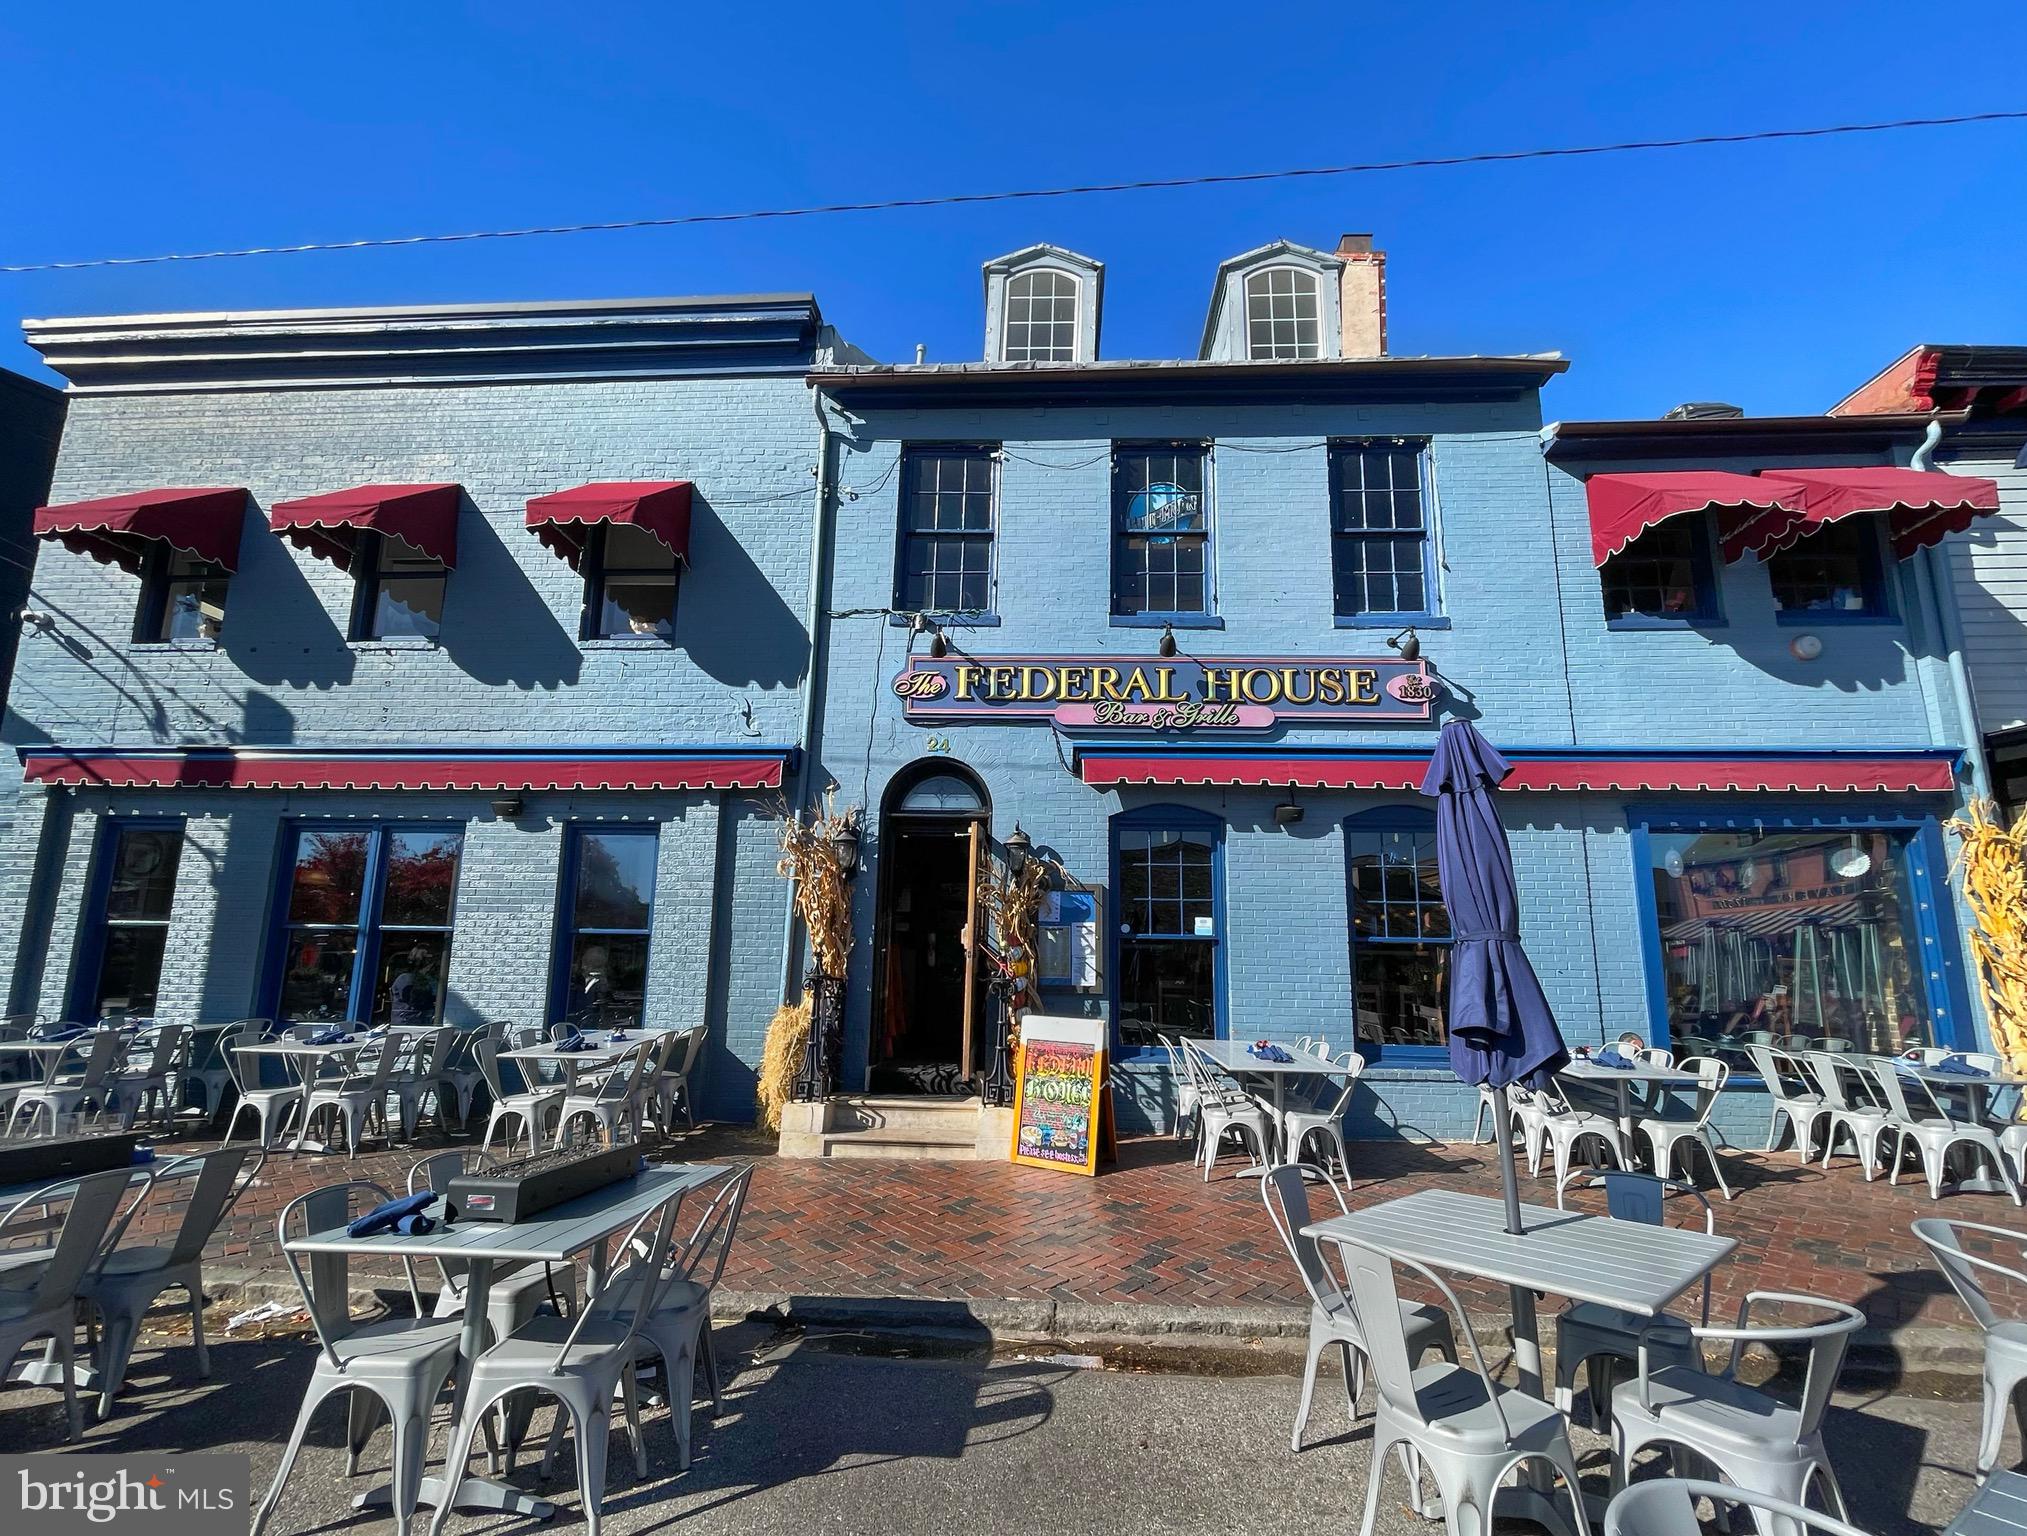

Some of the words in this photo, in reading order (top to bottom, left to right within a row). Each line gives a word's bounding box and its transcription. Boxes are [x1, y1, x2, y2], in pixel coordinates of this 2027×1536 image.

[893, 670, 944, 696] The
[954, 664, 1188, 702] FEDERAL
[1202, 667, 1380, 704] HOUSE
[1399, 685, 1433, 699] 1830
[1093, 700, 1149, 724] Bar
[1152, 706, 1171, 729] &
[1170, 700, 1240, 728] Grille
[927, 735, 951, 753] 24
